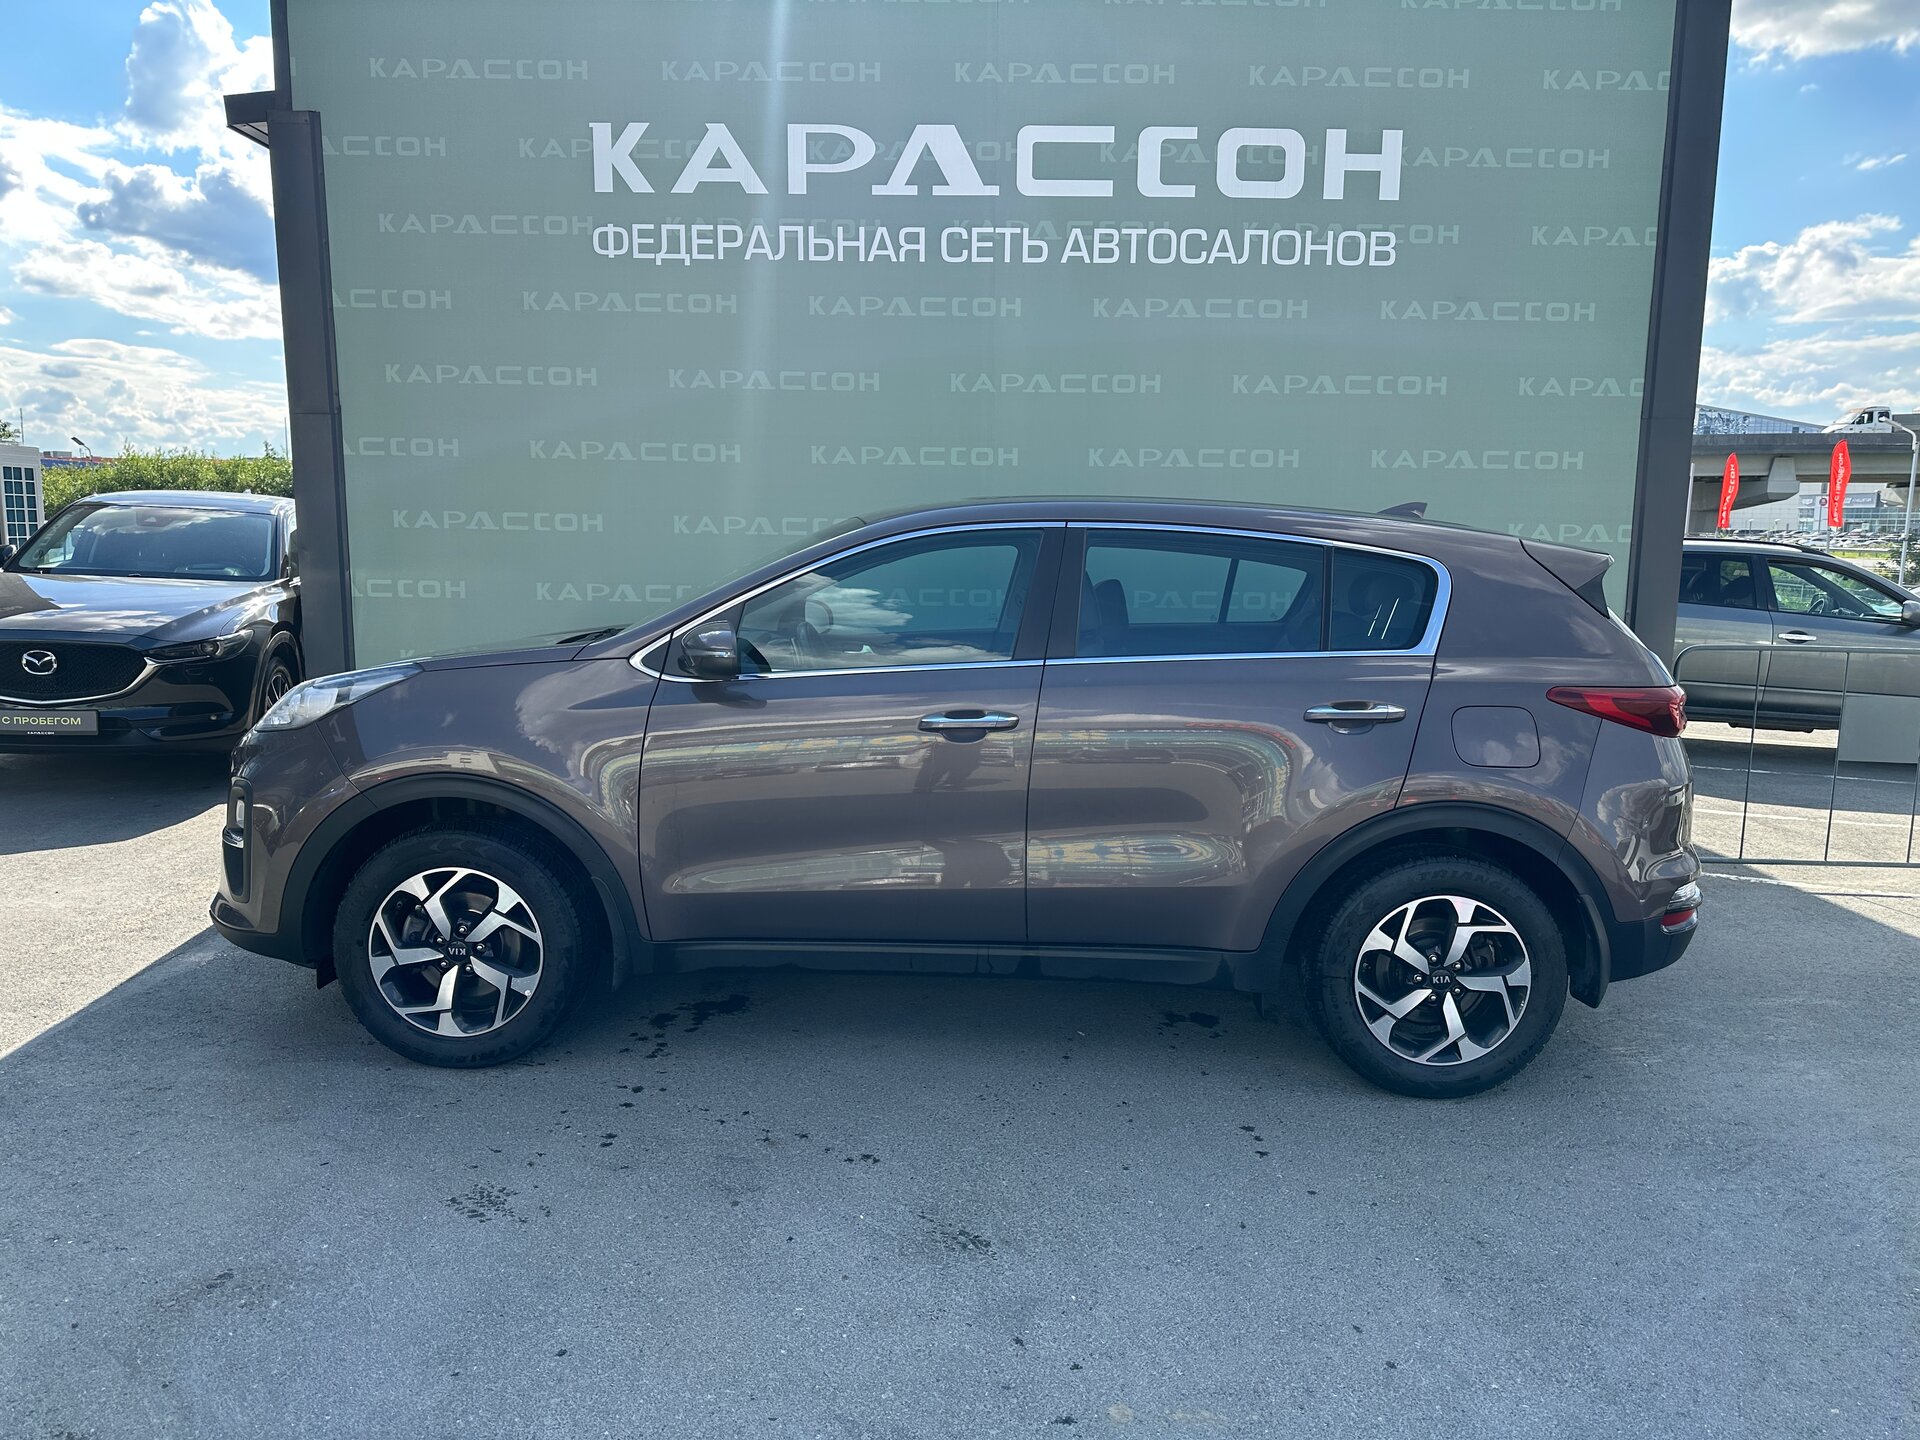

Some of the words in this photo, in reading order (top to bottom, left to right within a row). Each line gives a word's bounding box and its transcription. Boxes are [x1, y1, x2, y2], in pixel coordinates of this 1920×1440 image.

[592, 223, 926, 266] ФЕДЕРАЛЬНАЯ
[940, 226, 1049, 263] СЕТЬ
[1060, 227, 1397, 266] АВТОСАЛОНОВ
[333, 289, 452, 309] ССОН
[1, 716, 11, 725] С
[13, 716, 82, 726] ПРОБЕГОМ
[448, 946, 467, 956] KIA
[1432, 975, 1451, 984] KIA
